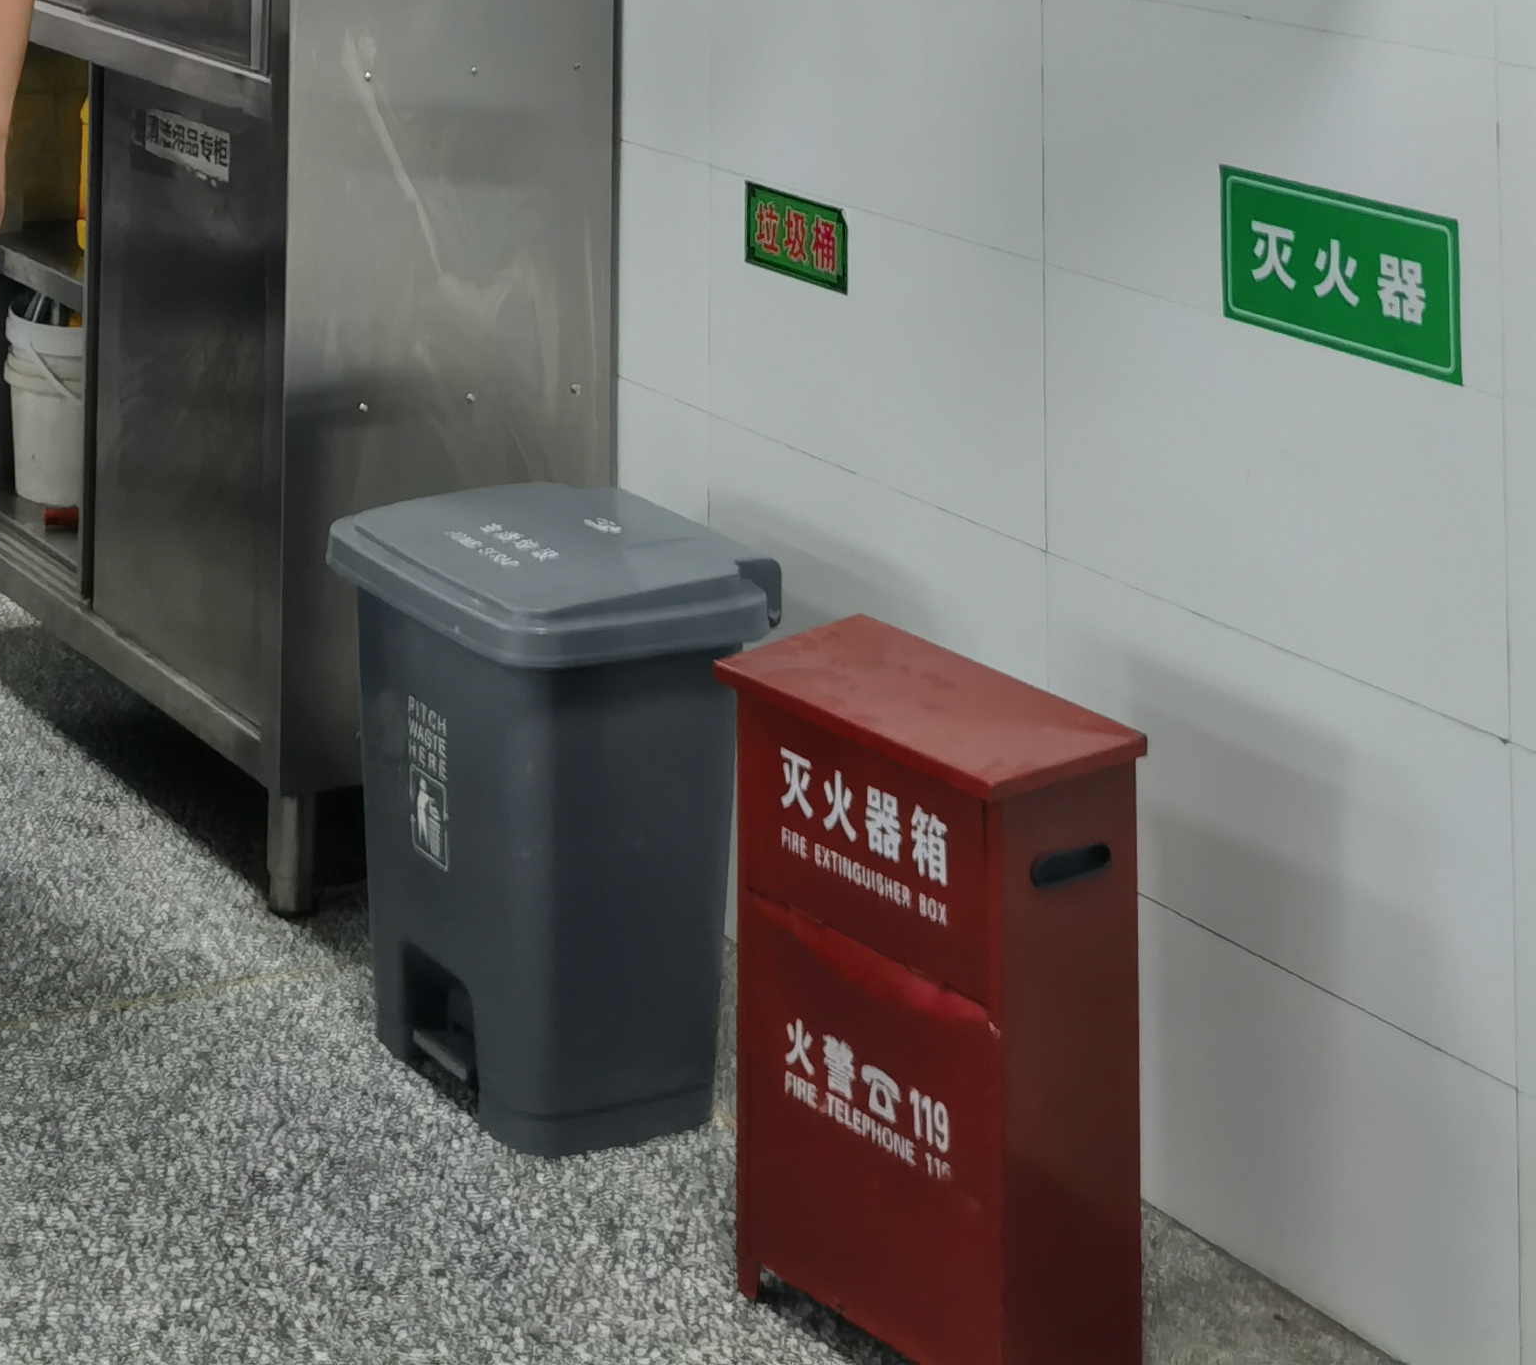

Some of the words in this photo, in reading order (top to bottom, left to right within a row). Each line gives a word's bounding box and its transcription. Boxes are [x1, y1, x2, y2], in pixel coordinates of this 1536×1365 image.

[755, 200, 836, 275] 垃圾桶
[1250, 218, 1427, 328] 灭火器
[407, 694, 448, 737] PITCH
[407, 717, 448, 761] WASTE
[407, 738, 449, 782] HERE
[780, 746, 949, 888] 灭火器箱
[780, 825, 809, 860] FIRE
[814, 843, 913, 909] EXTINGUISHER
[918, 892, 948, 928] BOX
[784, 1069, 817, 1110] FIRE
[825, 1092, 917, 1167] TELEPHONE
